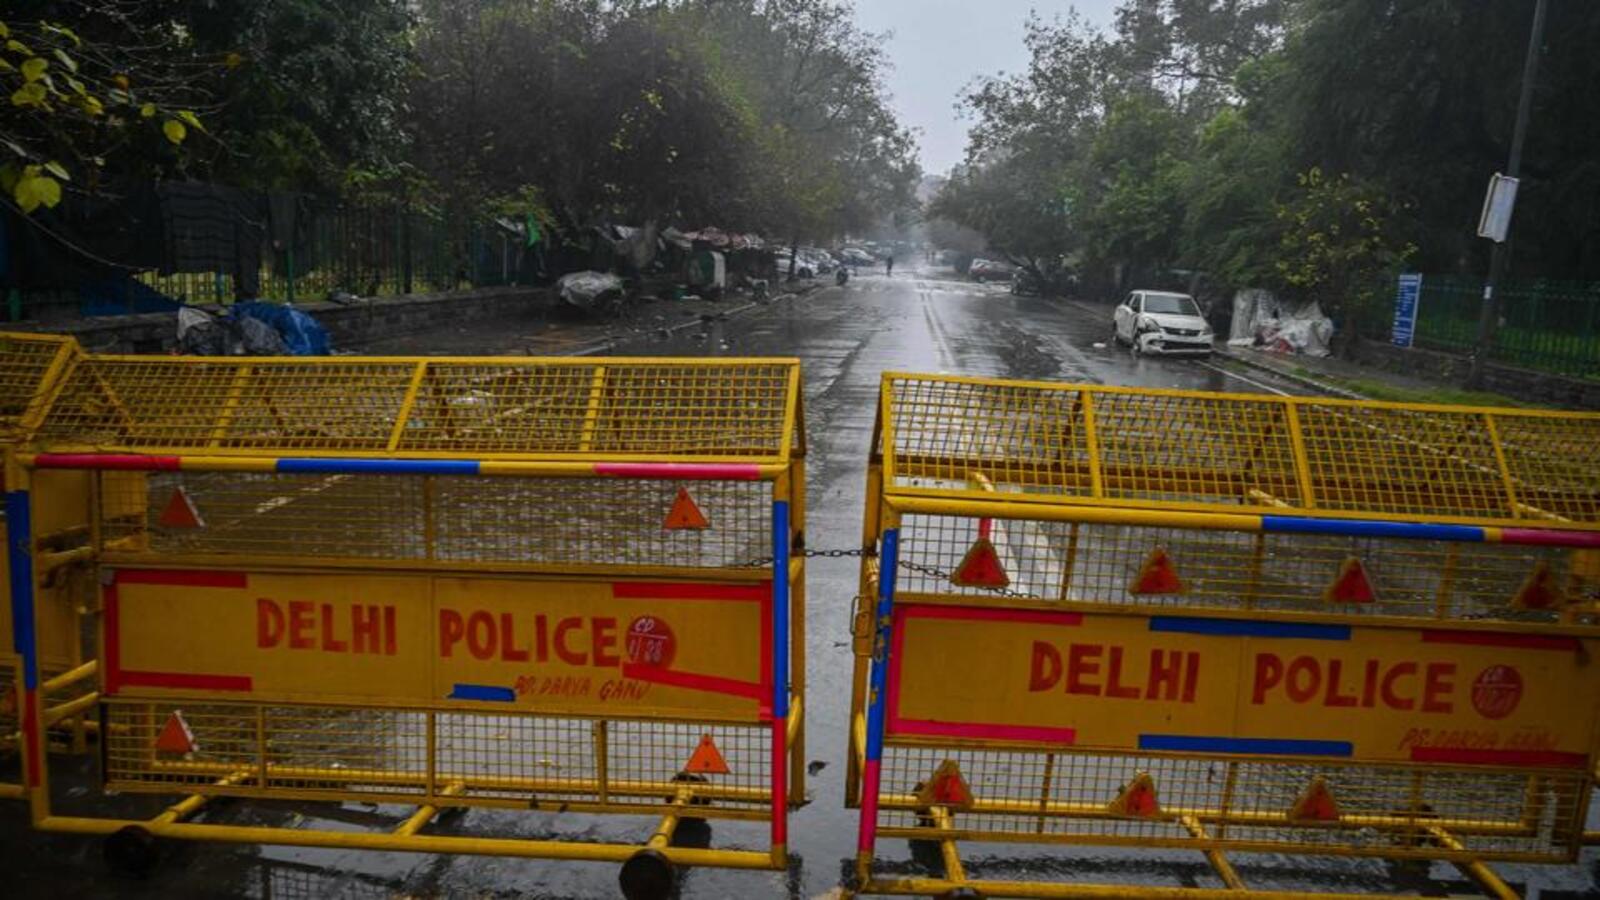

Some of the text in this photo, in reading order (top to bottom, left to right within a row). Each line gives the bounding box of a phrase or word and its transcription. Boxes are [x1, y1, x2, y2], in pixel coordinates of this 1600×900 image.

[257, 598, 620, 667] DELHI POLICE
[1029, 640, 1457, 714] DELHI POLICE
